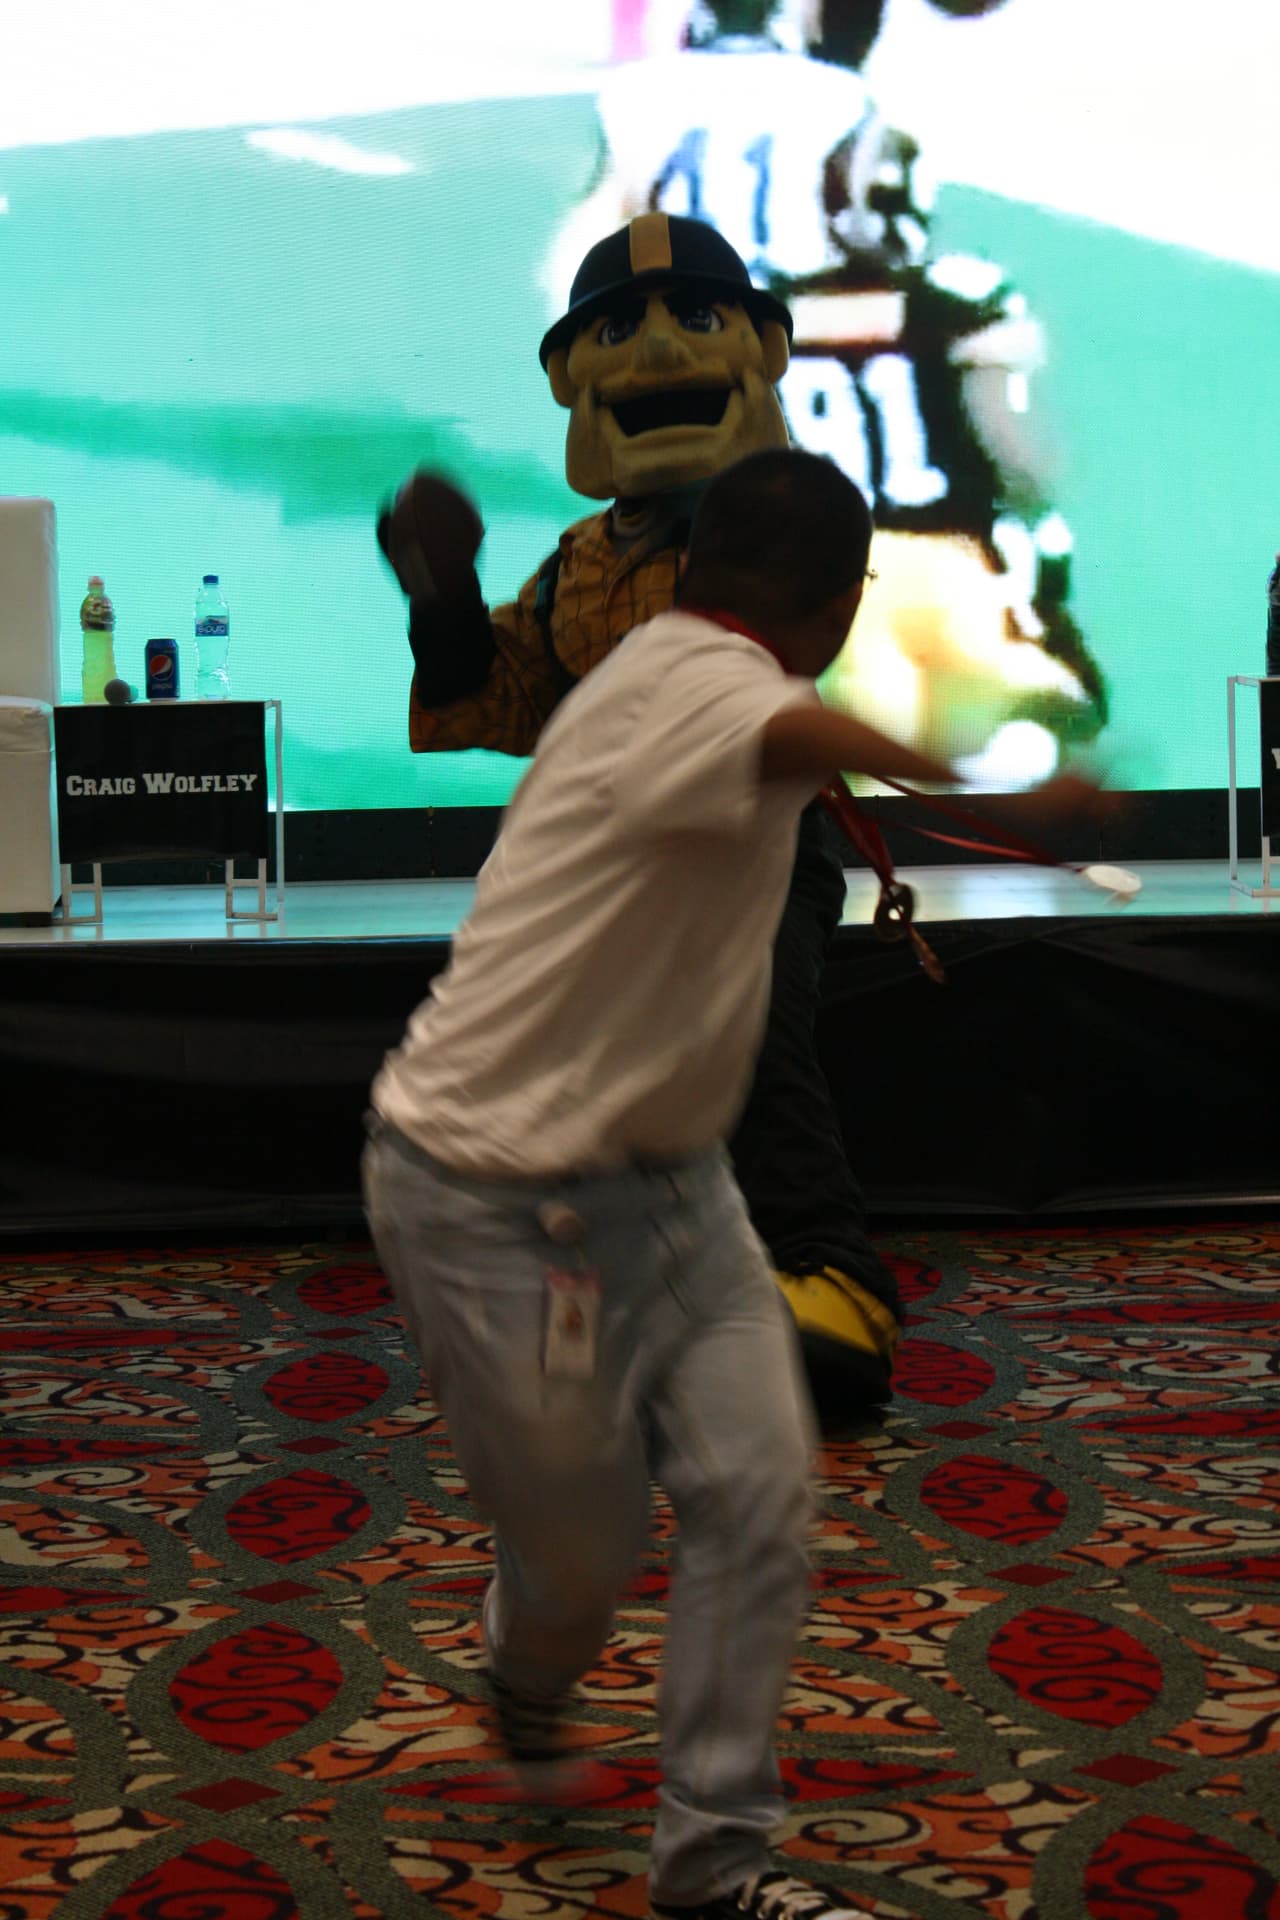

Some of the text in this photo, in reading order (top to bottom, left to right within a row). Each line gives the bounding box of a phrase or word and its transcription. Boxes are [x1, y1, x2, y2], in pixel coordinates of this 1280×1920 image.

[779, 352, 949, 508] 91
[66, 772, 258, 796] CRAIG WOLFLEY
